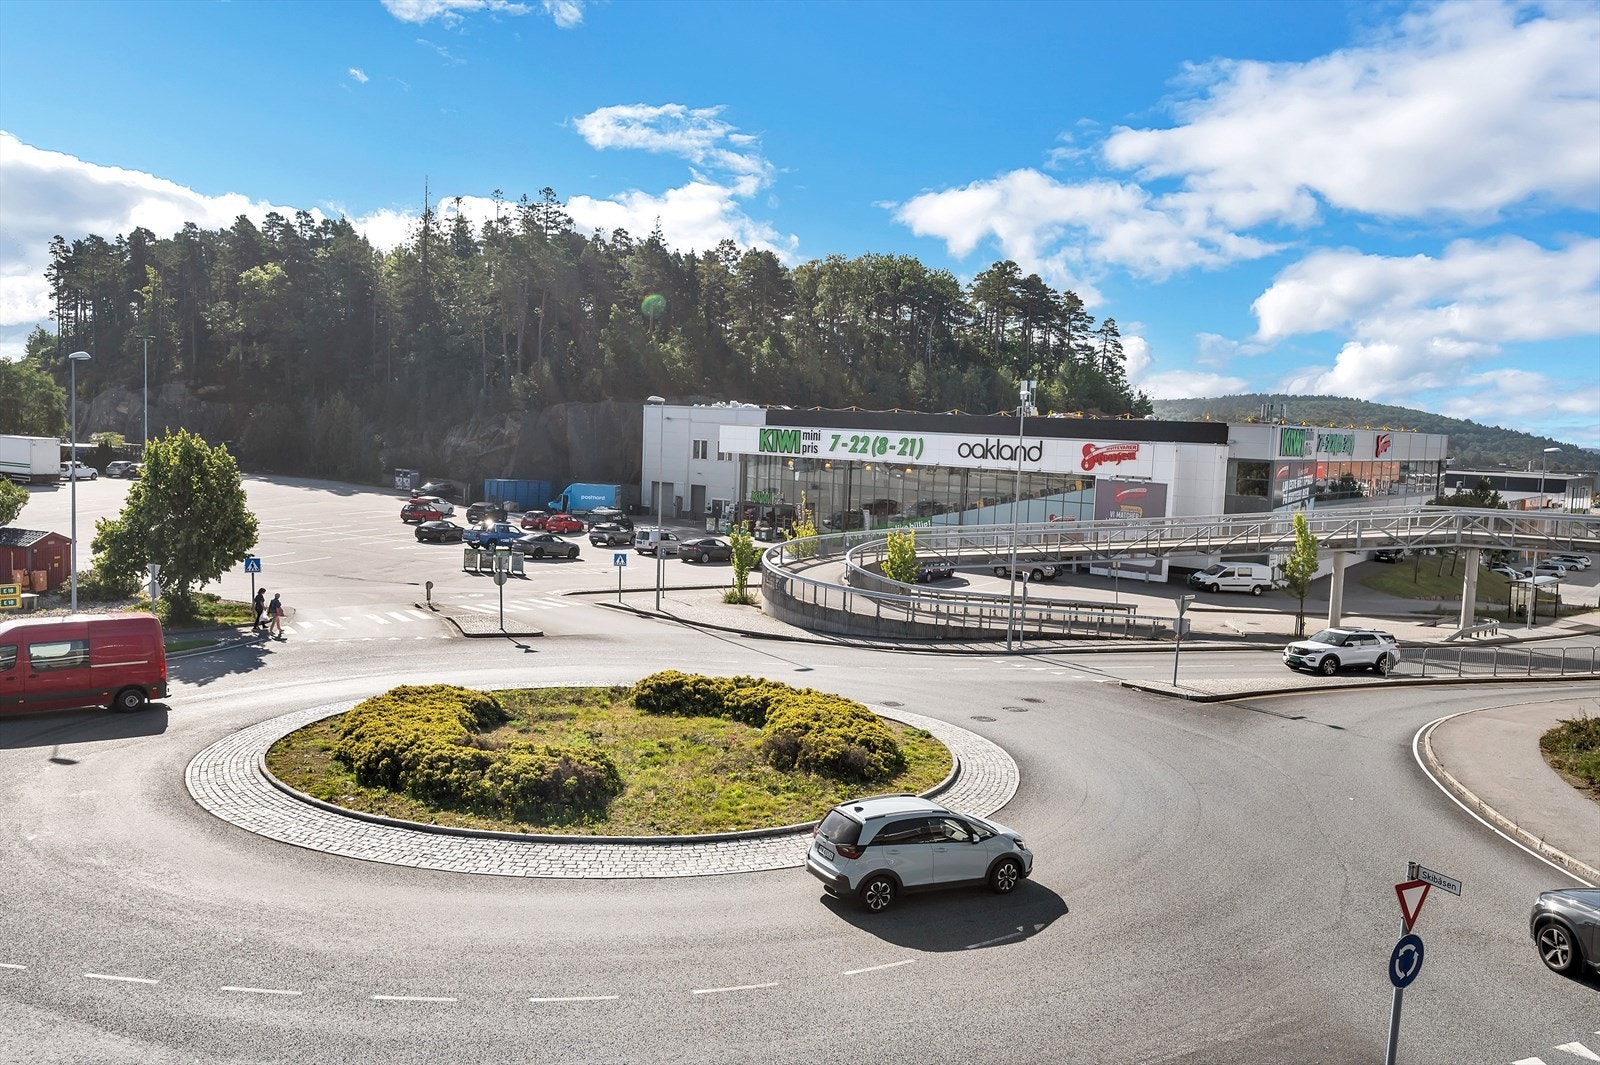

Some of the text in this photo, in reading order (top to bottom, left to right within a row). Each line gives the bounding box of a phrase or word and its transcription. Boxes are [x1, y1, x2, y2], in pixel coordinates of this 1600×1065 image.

[759, 428, 801, 454] KIWI
[802, 430, 821, 442] mini
[802, 442, 819, 455] pris
[957, 438, 1043, 462] oakland
[1422, 871, 1457, 891] Skibåsen
